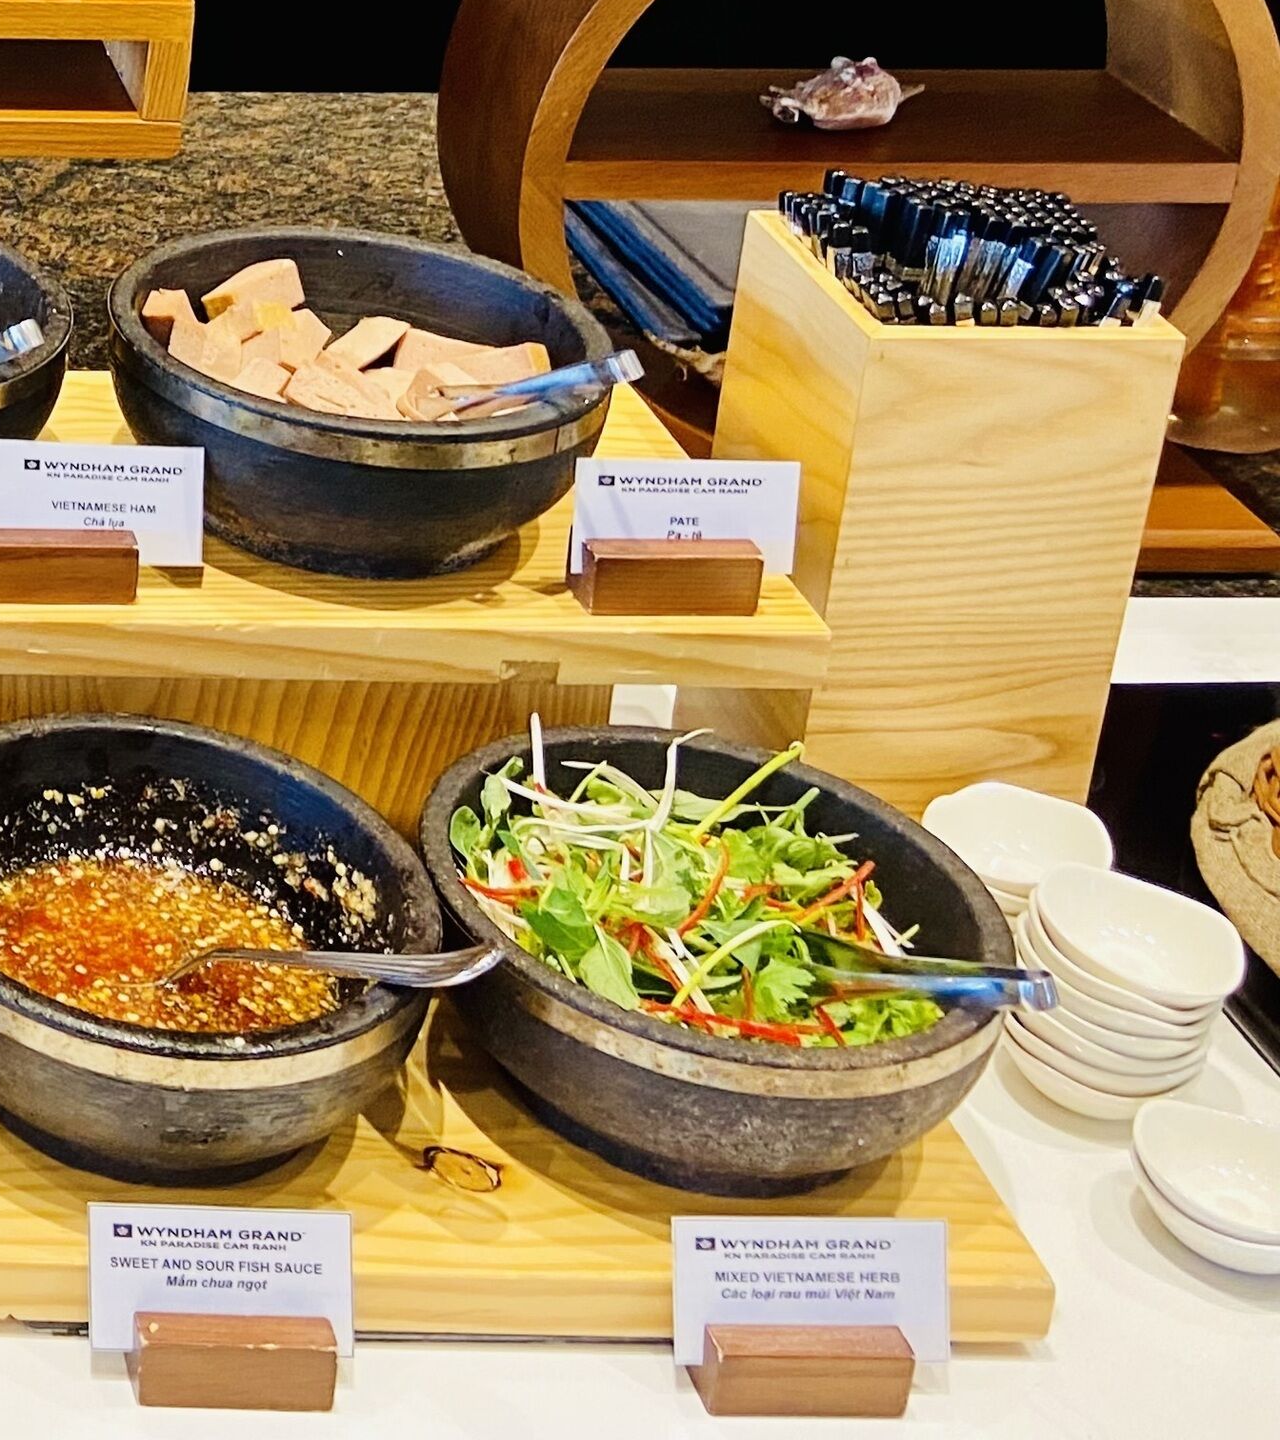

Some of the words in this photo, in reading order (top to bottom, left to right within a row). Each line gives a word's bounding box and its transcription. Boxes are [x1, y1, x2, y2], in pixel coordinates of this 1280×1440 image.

[44, 461, 125, 473] WYNDHAM
[129, 465, 184, 476] GRAND
[619, 476, 702, 486] WYNDHAM
[707, 477, 763, 487] GRAND
[51, 500, 127, 513] VIETNAMESE
[130, 504, 157, 514] HAM
[669, 517, 700, 526] PATE
[136, 1226, 233, 1240] WYNDHAM
[238, 1229, 303, 1243] GRAND
[160, 1240, 220, 1250] PARADISE
[223, 1242, 250, 1251] CAM
[252, 1243, 287, 1251] RANH
[721, 1239, 819, 1251] WYNDHAM
[825, 1239, 892, 1251] GRAND
[110, 1256, 159, 1271] SWEET
[161, 1259, 192, 1271] AND
[195, 1260, 236, 1273] SOUR
[239, 1261, 270, 1274] FISH
[274, 1262, 323, 1275] SAUCE
[714, 1271, 760, 1283] MIXED
[763, 1271, 856, 1283] VIETNAMESE
[859, 1271, 901, 1283] HERB
[201, 1277, 234, 1290] chua
[236, 1279, 268, 1292] ngọt
[778, 1290, 801, 1300] rau
[864, 1288, 896, 1300] Nam
